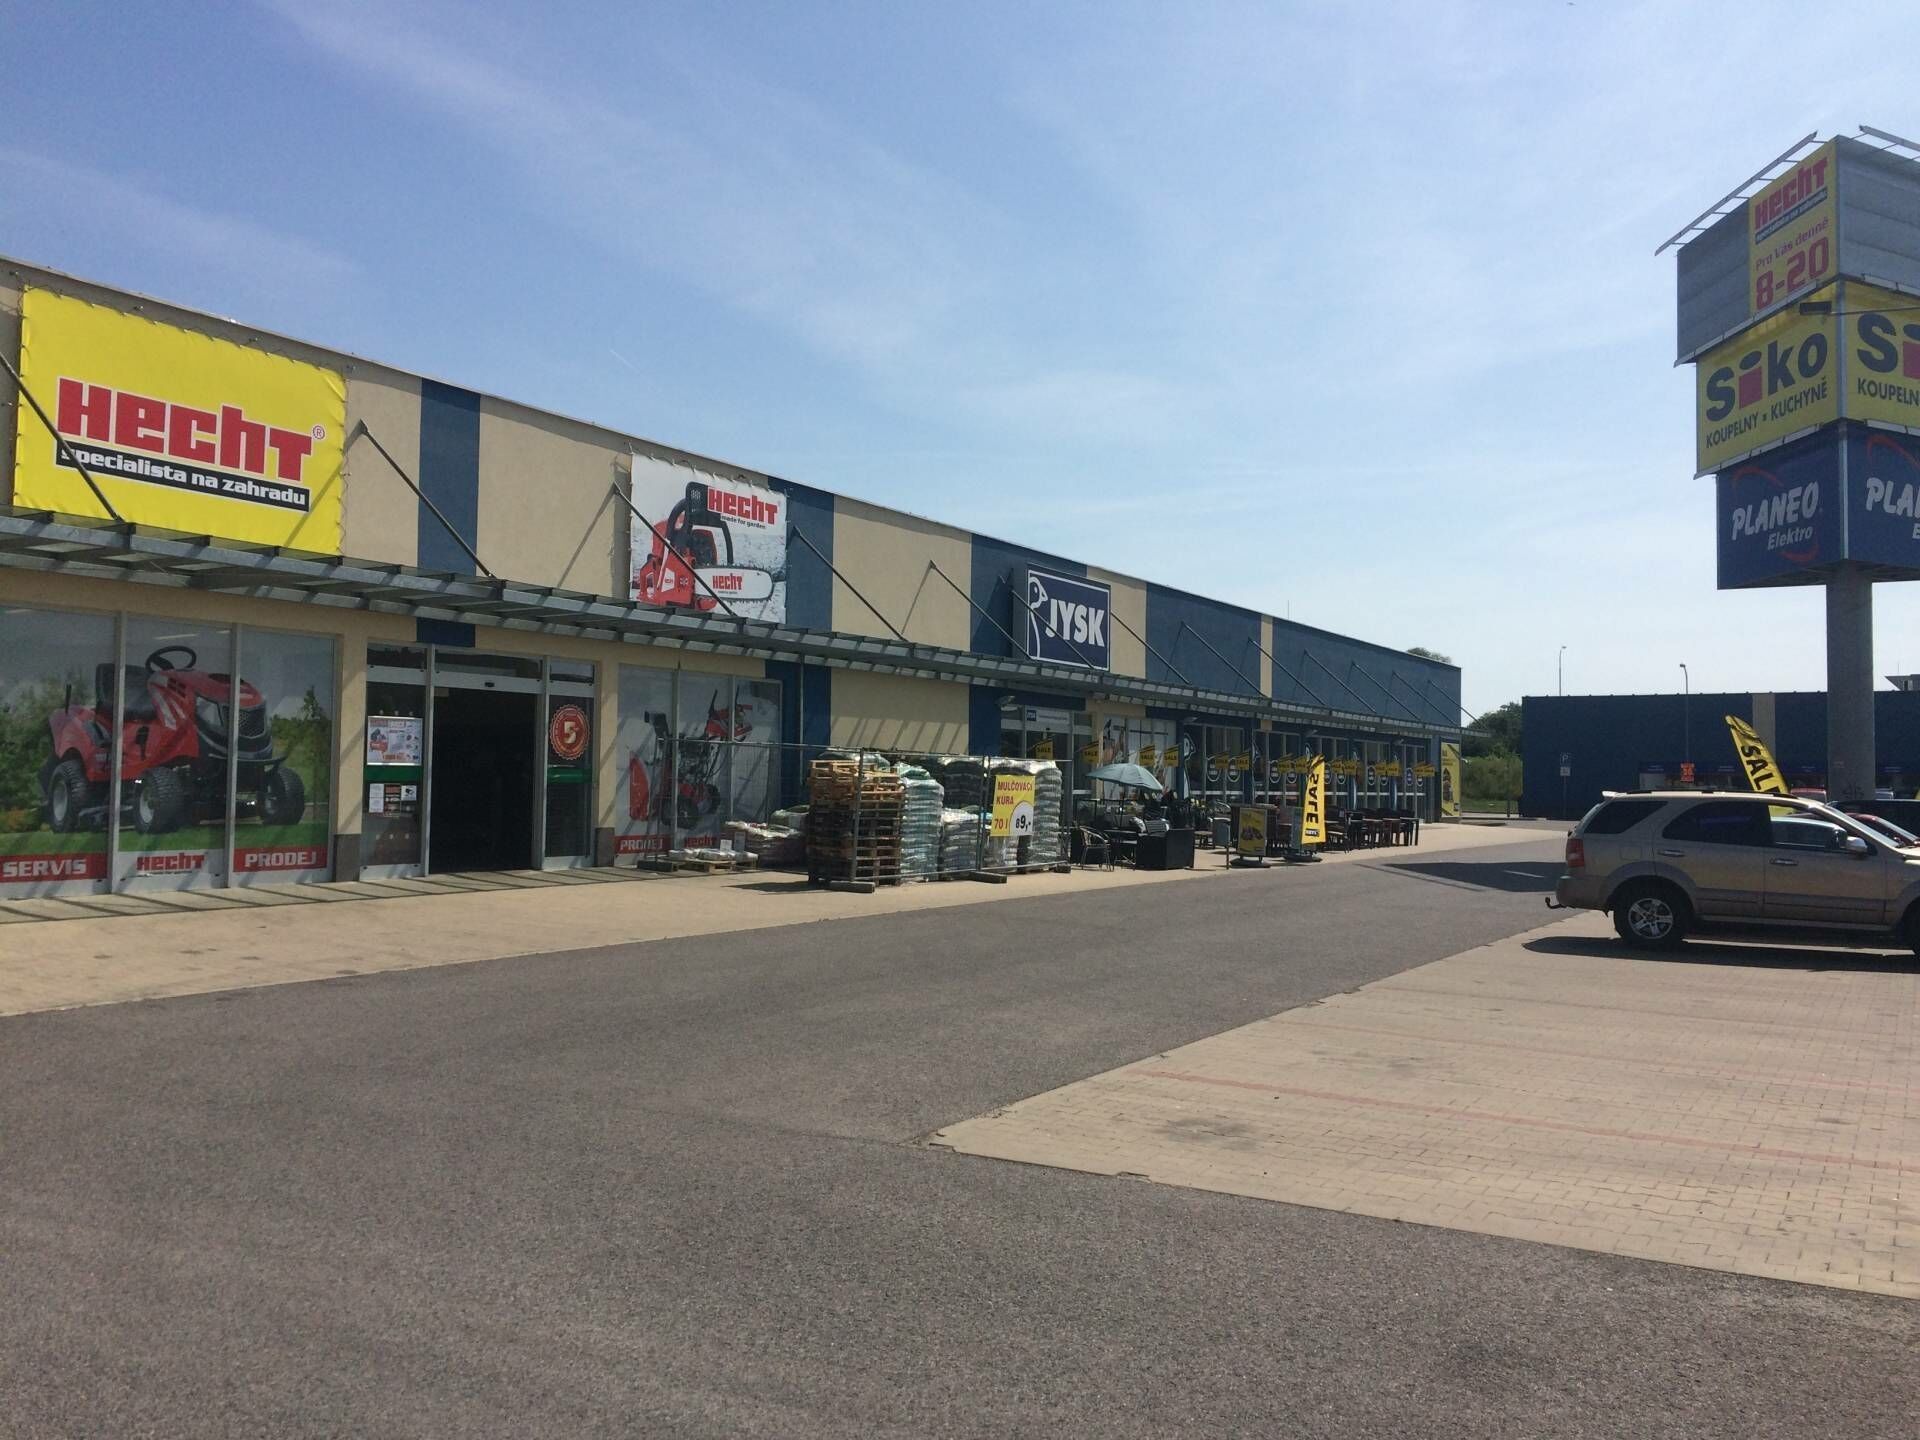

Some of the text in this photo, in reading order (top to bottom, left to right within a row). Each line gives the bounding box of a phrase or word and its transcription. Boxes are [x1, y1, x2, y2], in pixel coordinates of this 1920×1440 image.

[1756, 253, 1773, 271] Pro
[1756, 236, 1829, 311] 8-20
[1706, 378, 1828, 449] KOUPELNY KUCHYNĚ
[60, 448, 306, 506] specialista na zahradu
[1866, 477, 1920, 519] PLA
[1731, 480, 1820, 542] PLANEO
[1767, 525, 1814, 551] Elektro
[1045, 599, 1104, 647] JYSK
[994, 818, 1004, 829] 70
[2, 857, 88, 878] SERVIS
[244, 850, 317, 868] PRODEJ
